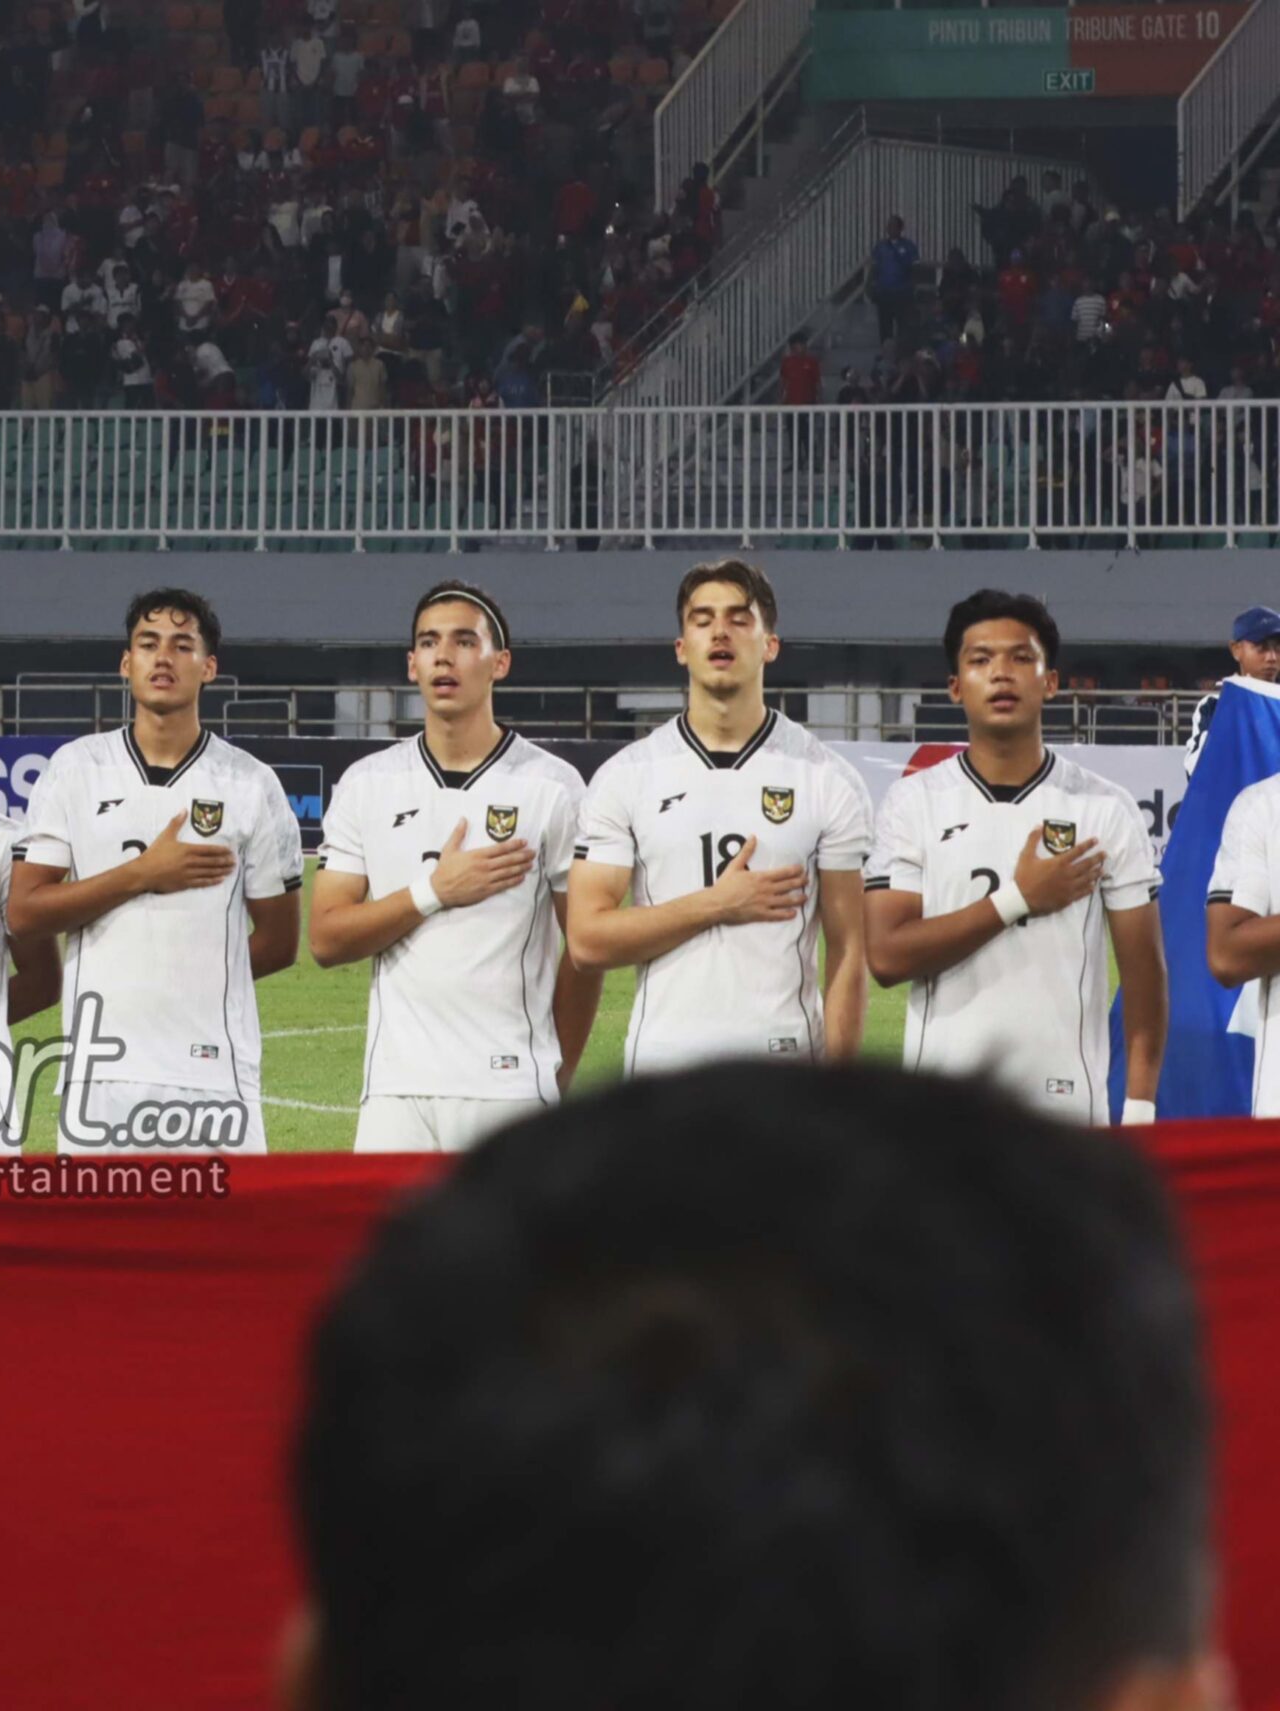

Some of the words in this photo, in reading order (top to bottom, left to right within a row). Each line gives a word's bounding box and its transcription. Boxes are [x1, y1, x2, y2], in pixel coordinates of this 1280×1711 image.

[928, 18, 979, 43] PINTU
[987, 17, 1051, 43] TRIBUN
[1065, 15, 1136, 41] TRIBUNE
[1141, 14, 1186, 39] GATE
[1195, 11, 1220, 40] 10
[1045, 72, 1091, 90] EXIT
[699, 831, 750, 888] 18
